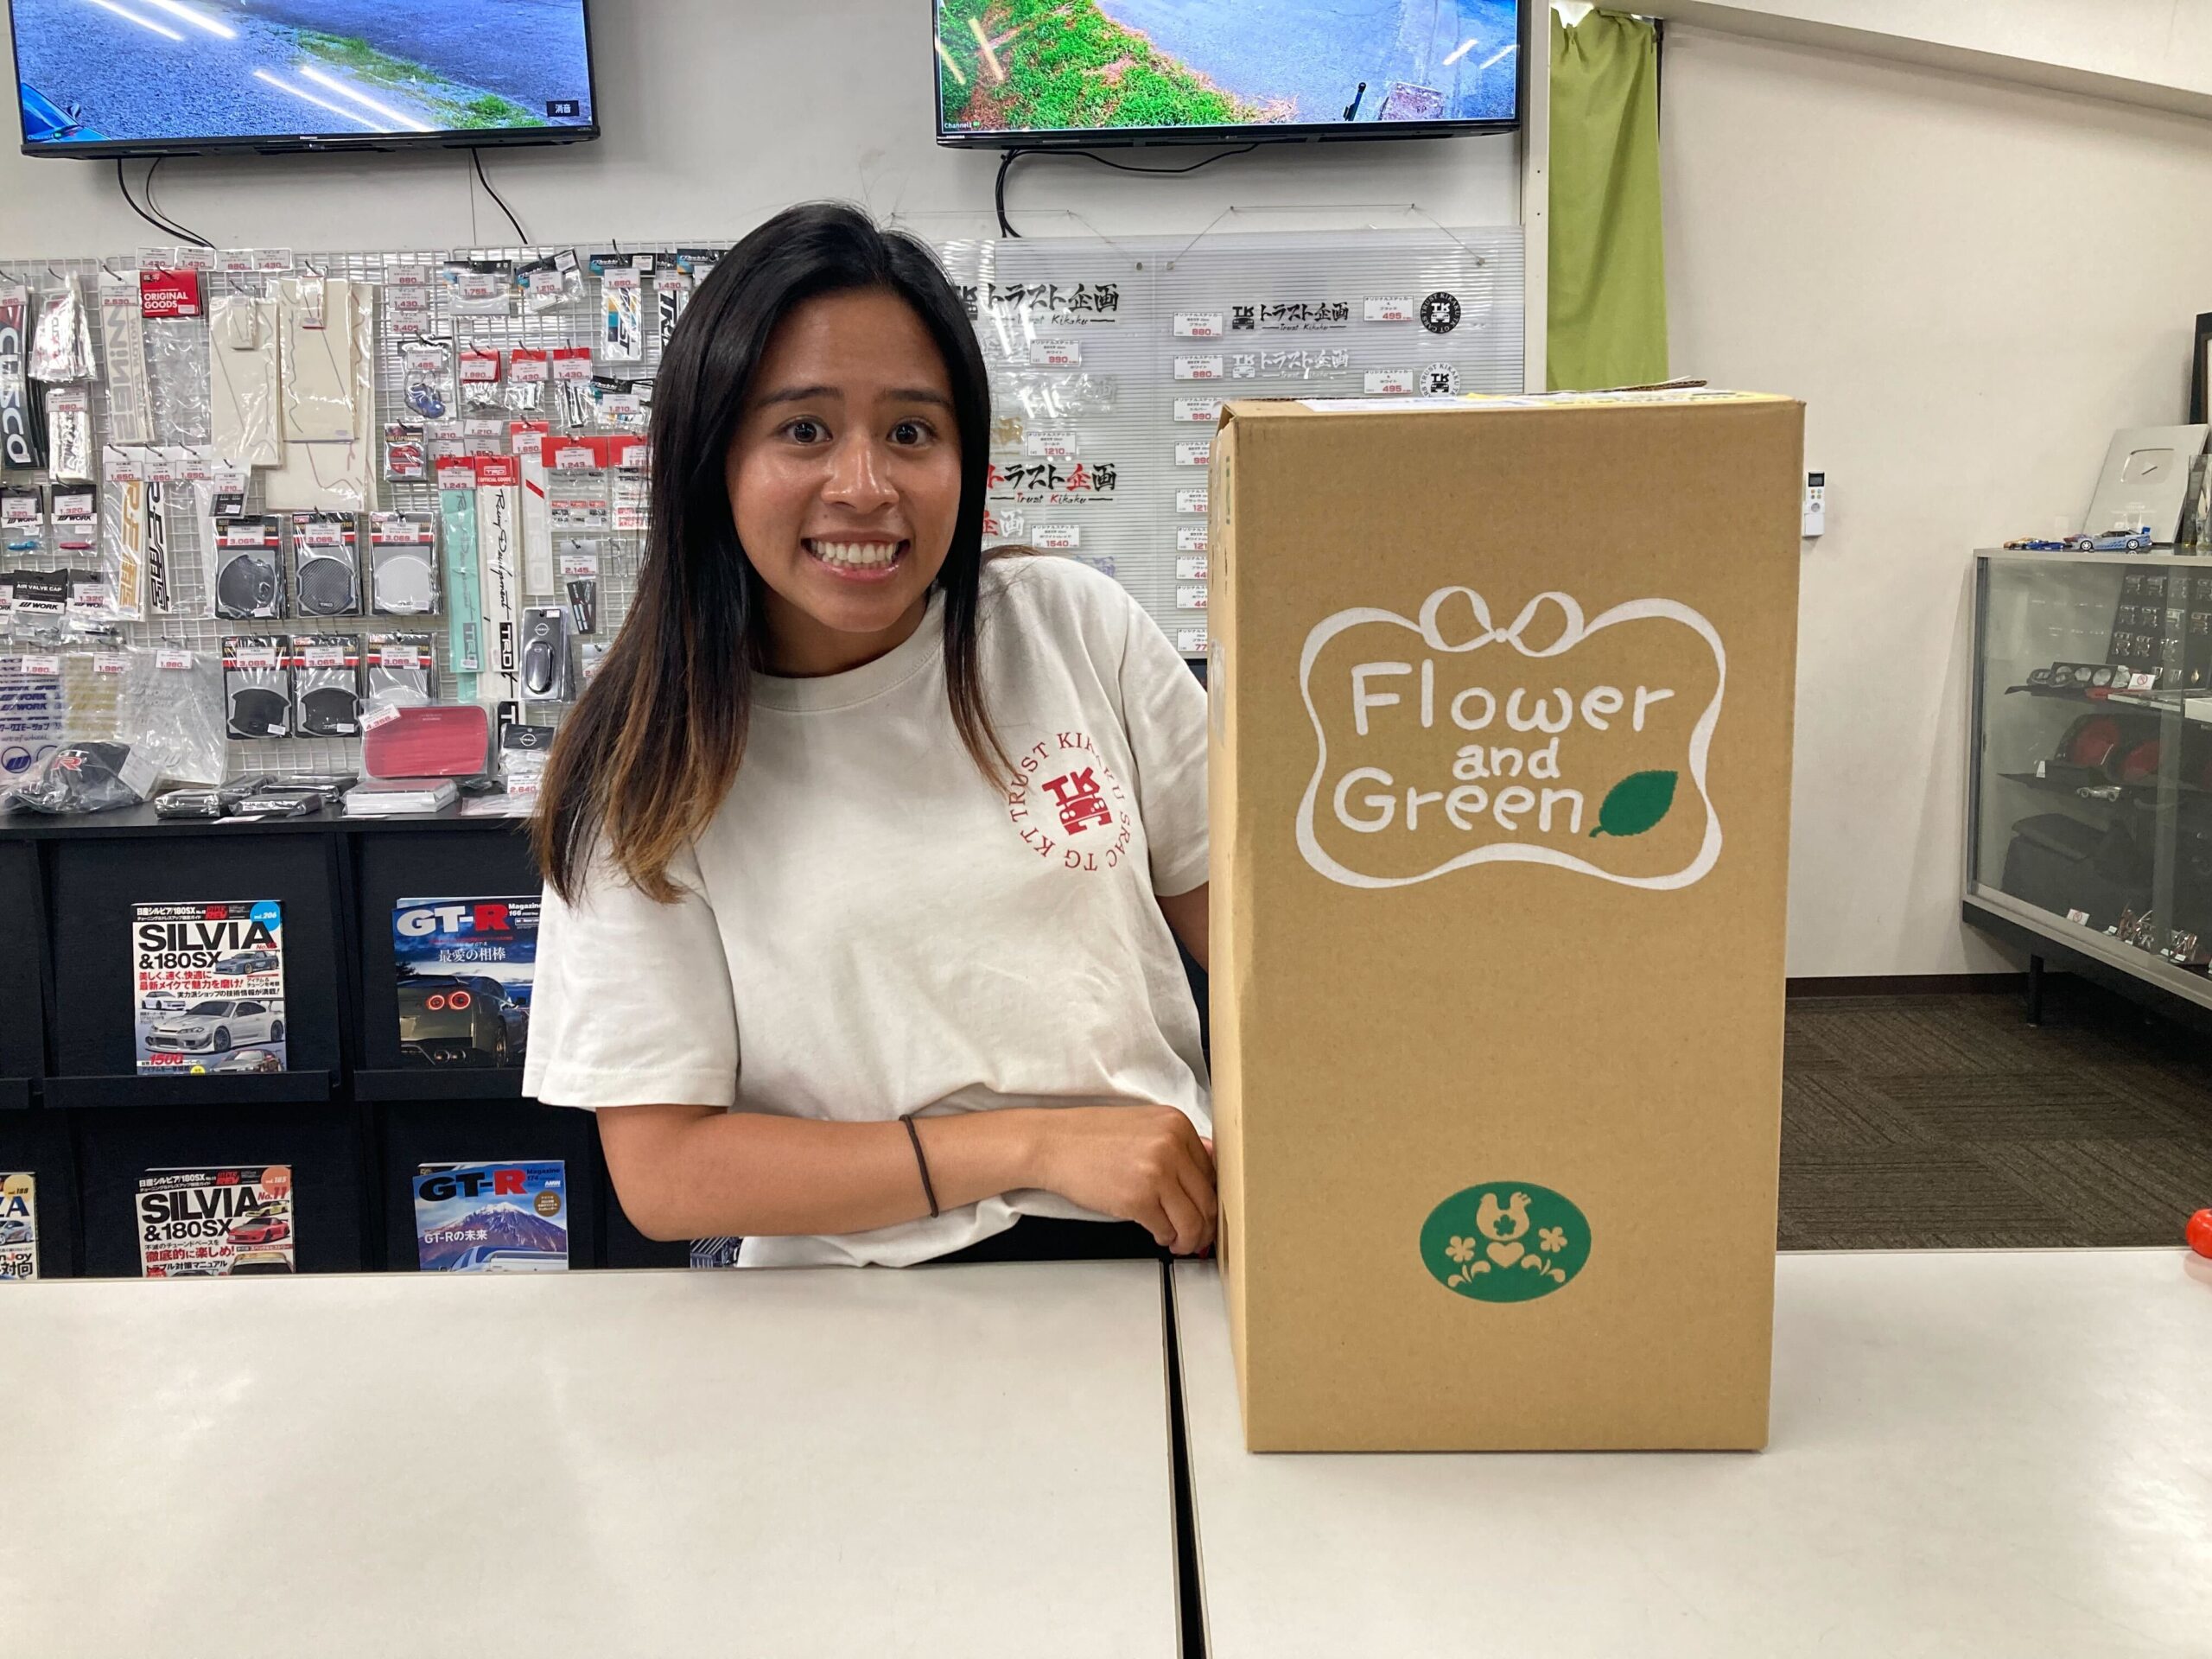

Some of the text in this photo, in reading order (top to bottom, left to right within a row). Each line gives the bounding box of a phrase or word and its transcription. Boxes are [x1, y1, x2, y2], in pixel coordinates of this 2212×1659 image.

[555, 104, 570, 113] 消音
[658, 282, 682, 290] 1,430
[143, 291, 188, 301] ORIGINAL
[145, 300, 178, 309] GOODS
[1260, 302, 1350, 322] トラスト企画
[1431, 302, 1451, 313] TK
[1260, 349, 1349, 371] トラスト企画
[1016, 492, 1087, 504] Trust Kikaku
[1046, 539, 1070, 548] 1540
[1351, 658, 1675, 736] Flower
[1452, 737, 1561, 780] and
[1008, 741, 1051, 823] TRUST
[1333, 766, 1585, 834] Green
[396, 904, 510, 937] GT-R
[138, 921, 276, 952] SILVIA
[138, 951, 222, 969] &180SX
[439, 947, 506, 963] 最愛の相棒
[139, 971, 212, 981] 美しく、速く、快適に
[139, 980, 243, 991] 最新メイクで魅力を磨け!
[257, 1187, 287, 1201] No.11
[419, 1169, 529, 1202] GT-R
[141, 1186, 259, 1224] SILVIA
[143, 1218, 232, 1243] &180SX
[424, 1229, 488, 1244] GT-Rの未来
[146, 1246, 235, 1263] 徹底的に楽しめ!
